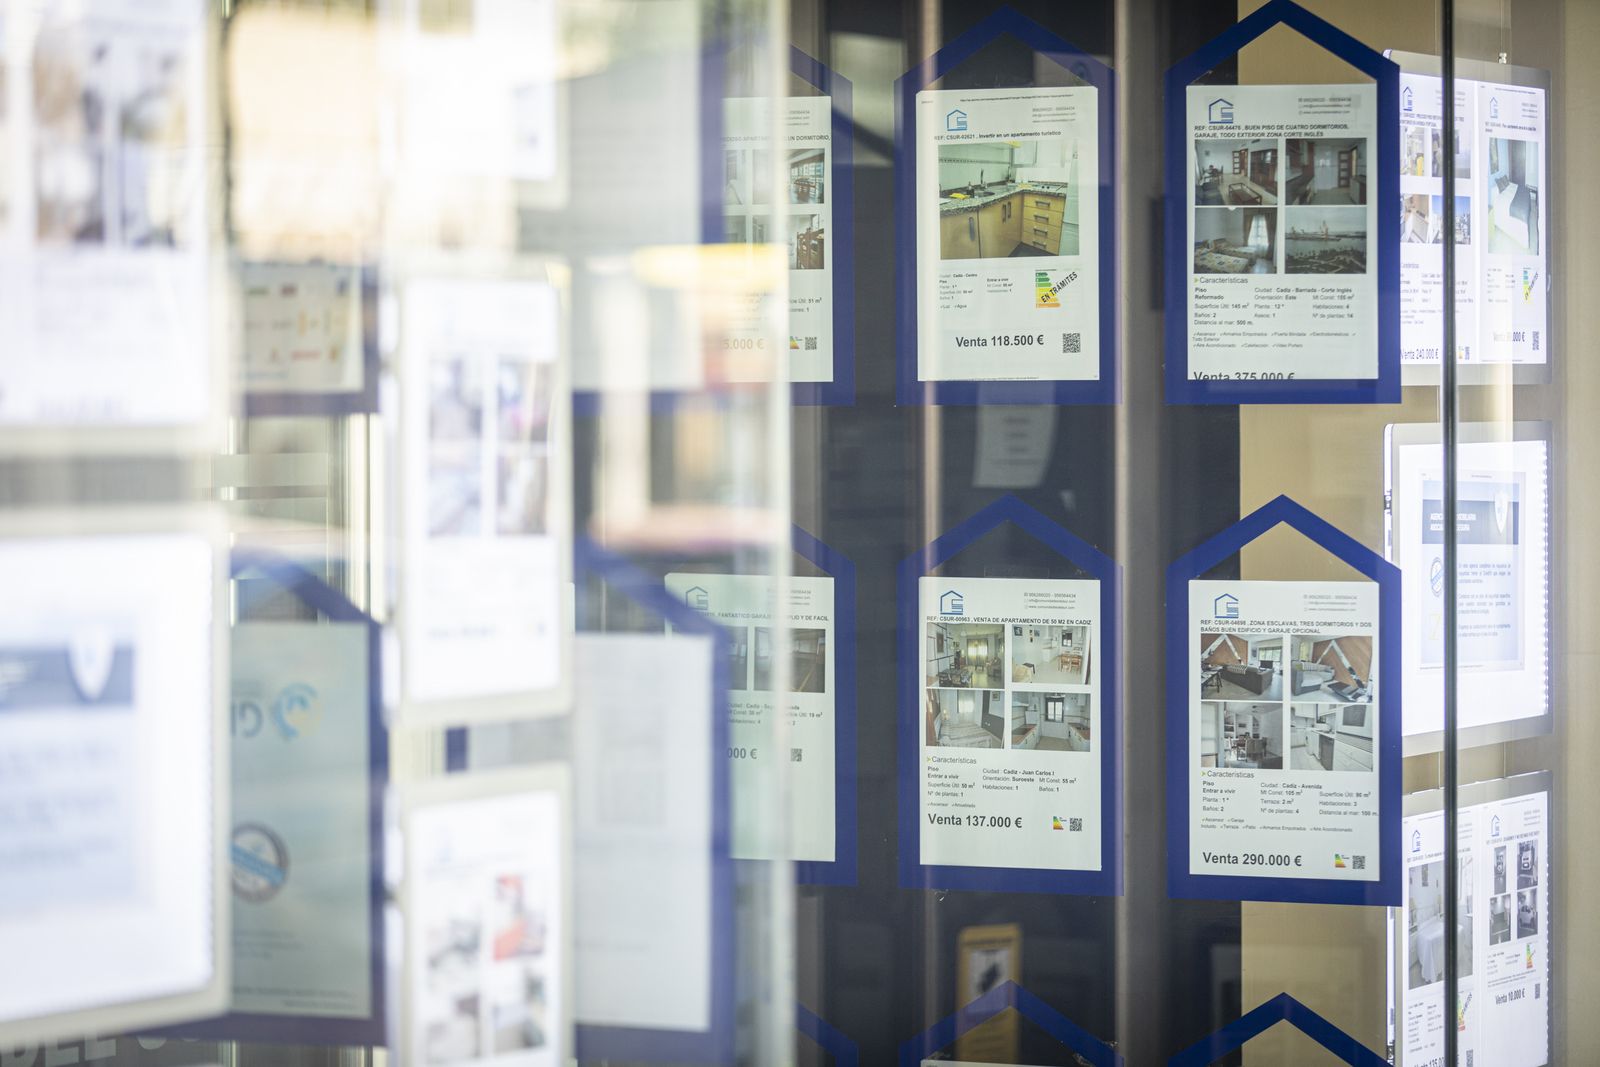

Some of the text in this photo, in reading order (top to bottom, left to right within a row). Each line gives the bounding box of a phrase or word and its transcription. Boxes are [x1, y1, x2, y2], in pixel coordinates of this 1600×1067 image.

[955, 334, 1044, 347] Venta 118.500 €
[1193, 371, 1230, 380] Venta
[750, 748, 758, 760] €
[928, 814, 1022, 828] Venta 137.000 €
[1202, 852, 1302, 866] Venta 290.000 €
